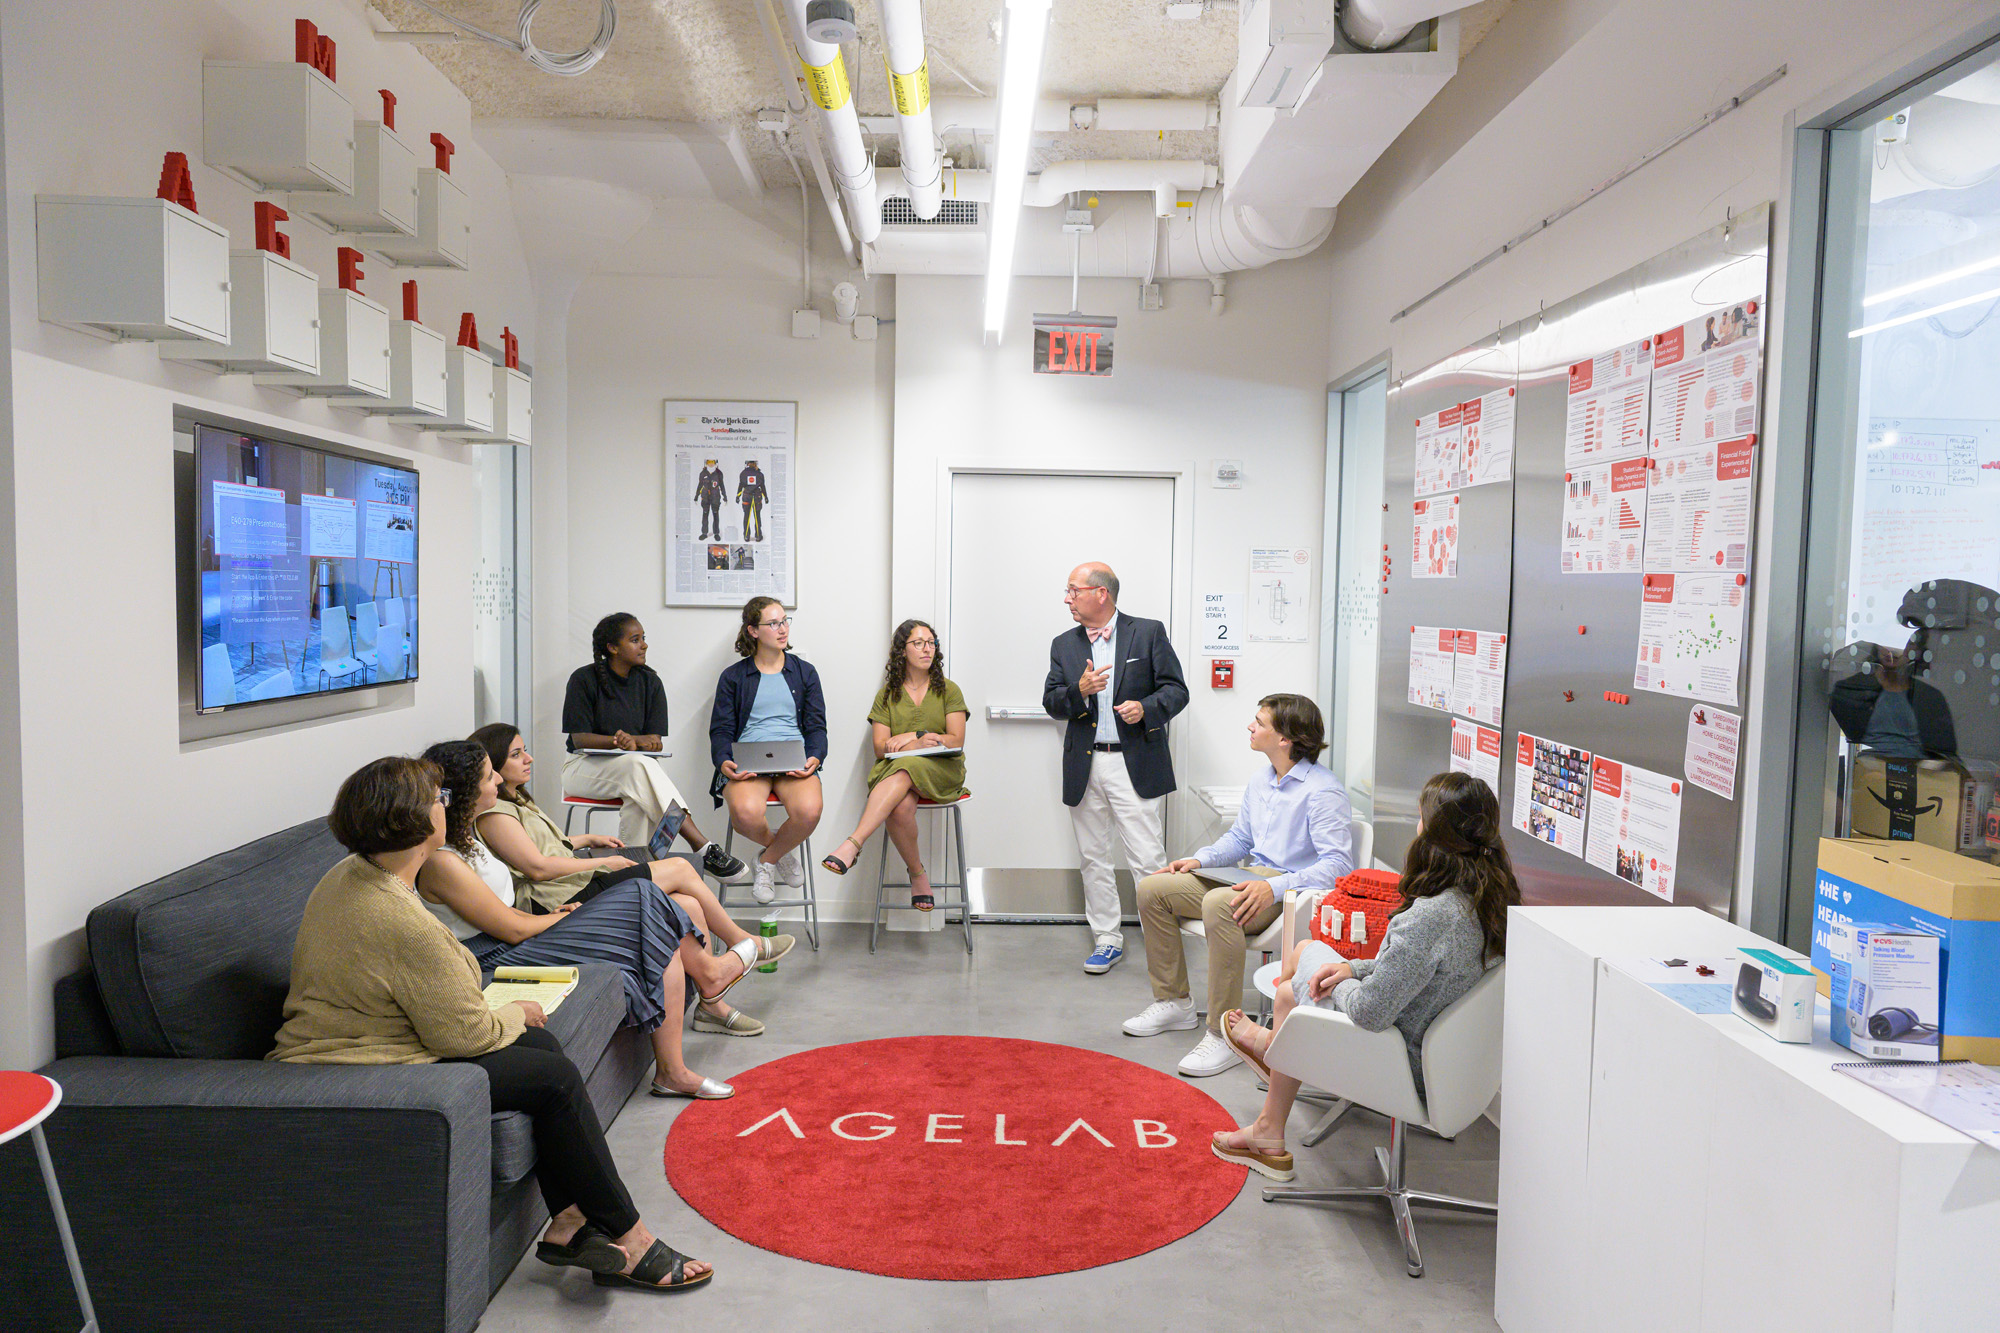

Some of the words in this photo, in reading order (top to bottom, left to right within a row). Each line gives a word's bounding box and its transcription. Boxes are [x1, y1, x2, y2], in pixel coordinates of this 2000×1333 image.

[1048, 331, 1102, 372] EXIT
[727, 417, 741, 425] York
[1721, 460, 1743, 468] Experiences
[400, 494, 410, 505] PM
[231, 516, 252, 526] E40-279
[1218, 625, 1228, 639] 2
[1713, 713, 1735, 725] CAREGIVING
[1702, 730, 1713, 738] HOME
[1714, 733, 1733, 745] LOGISTICS
[1718, 743, 1736, 754] SERVICES
[1694, 754, 1714, 767] LONGEVITY
[1715, 762, 1734, 774] PLANNING
[1708, 751, 1731, 764] RETIREMENT
[1697, 767, 1729, 784] TRANSPORTATION
[1690, 772, 1705, 783] LIVABLE
[1706, 778, 1731, 794] COMMUNITIES
[1892, 829, 1912, 839] prime
[736, 1108, 1178, 1149] AGELAB
